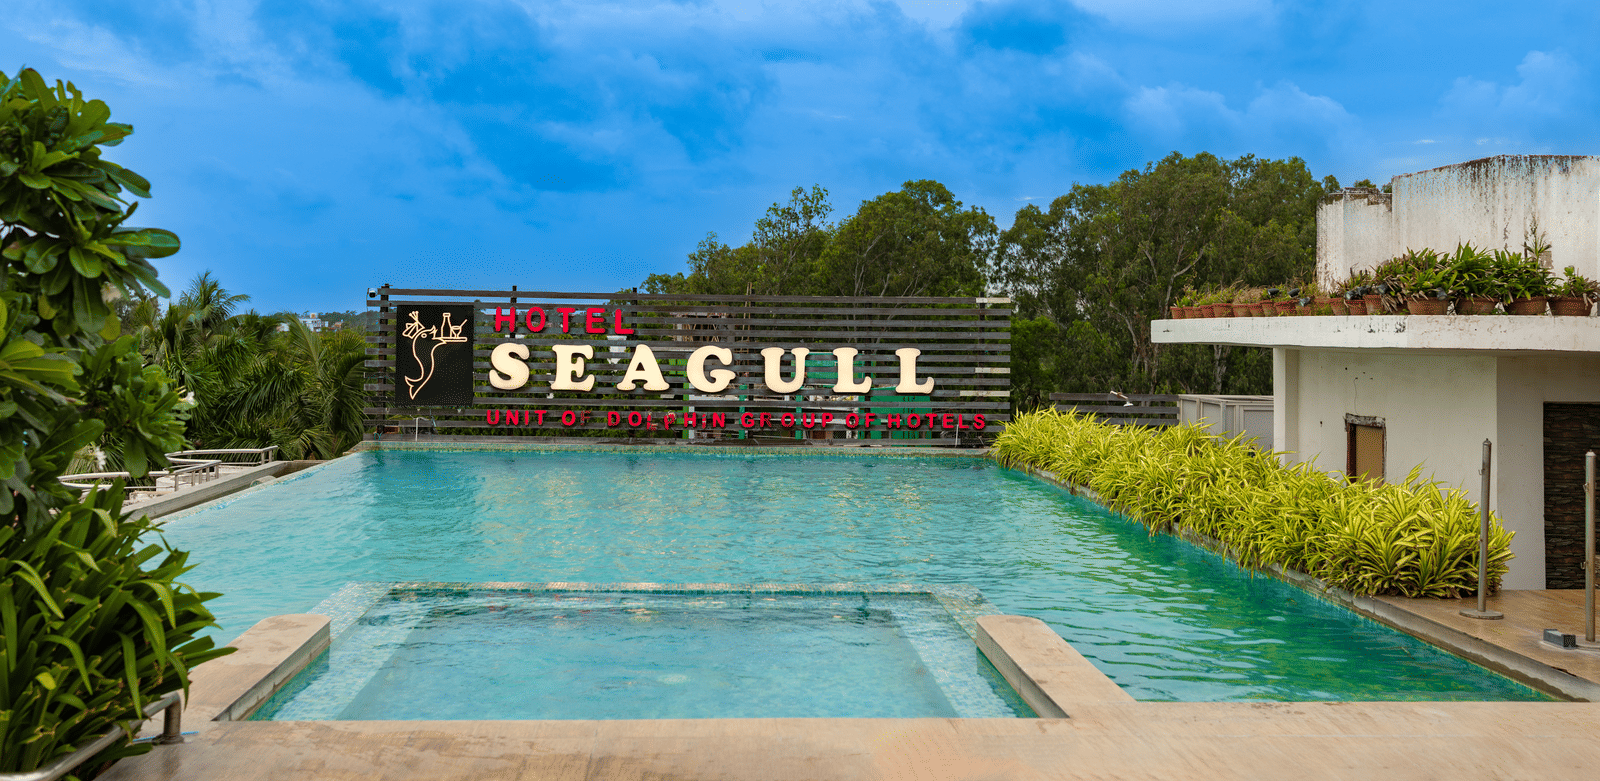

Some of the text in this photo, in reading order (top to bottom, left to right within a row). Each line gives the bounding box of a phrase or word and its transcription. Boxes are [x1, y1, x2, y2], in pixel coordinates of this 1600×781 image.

[494, 306, 634, 335] HOTEL
[489, 342, 935, 395] SEAGULL
[486, 409, 986, 430] UNIT OF DOLPHIN GROUP OF HOTELS
